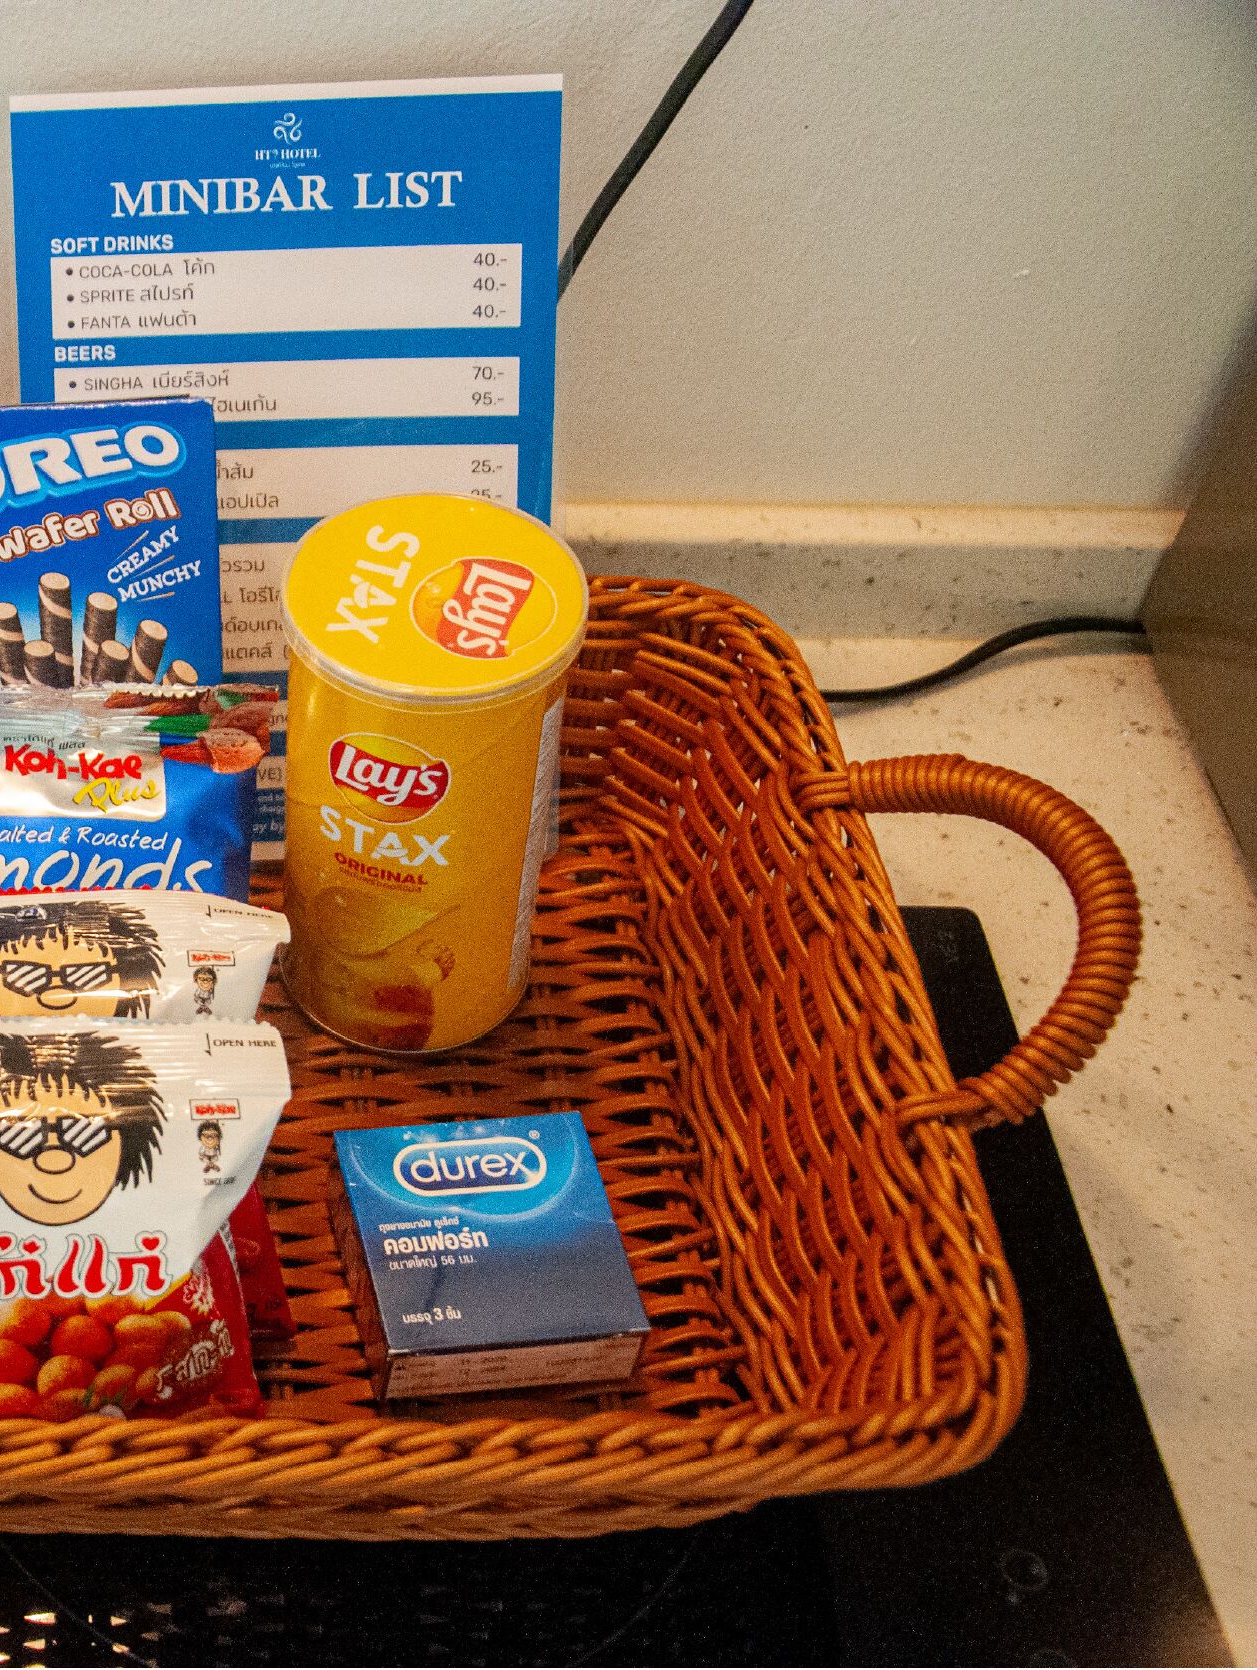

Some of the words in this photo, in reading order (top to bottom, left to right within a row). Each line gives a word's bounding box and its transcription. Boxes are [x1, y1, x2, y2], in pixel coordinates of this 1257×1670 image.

[281, 148, 321, 159] HOTEL
[110, 174, 333, 219] MINIBAR
[353, 170, 463, 209] LIST
[50, 237, 99, 254] SOFT
[103, 234, 174, 253] DRINKS
[79, 263, 173, 279] COCA-COLA
[183, 258, 215, 276] โค้ก
[473, 252, 507, 267] 40.-
[472, 276, 507, 291] 40.-
[80, 289, 135, 304] SPRITE
[81, 315, 131, 330] FANTA
[138, 309, 197, 328] แฟนต้า
[472, 304, 506, 318] 40.-
[54, 345, 116, 363] BEERS
[84, 375, 143, 391] SINGHA
[152, 369, 230, 389] เบียร์สิงห์
[472, 366, 504, 380] 70.-
[471, 391, 504, 406] 95.-
[471, 459, 502, 473] 25.-
[104, 488, 180, 529] Roll
[107, 526, 180, 584] CREAMY
[118, 560, 202, 603] MUNCHY
[325, 525, 421, 644] STAX
[442, 563, 532, 656] Lay's
[4, 744, 142, 781] Koh-Kae
[335, 745, 443, 806] Lay's
[74, 777, 163, 814] Plus
[58, 828, 70, 845] &
[77, 827, 167, 850] Roasted
[319, 804, 451, 867] STAX
[334, 852, 429, 885] ORIGINAL
[213, 1039, 244, 1047] OPEN
[248, 1039, 277, 1048] HERE
[410, 1150, 539, 1184] durex
[383, 1226, 489, 1256] คอมฟอร์ท
[440, 1255, 456, 1266] 56
[402, 1312, 434, 1325] บรรจุ
[433, 1307, 444, 1321] 3
[446, 1304, 462, 1320] ชิ้น
